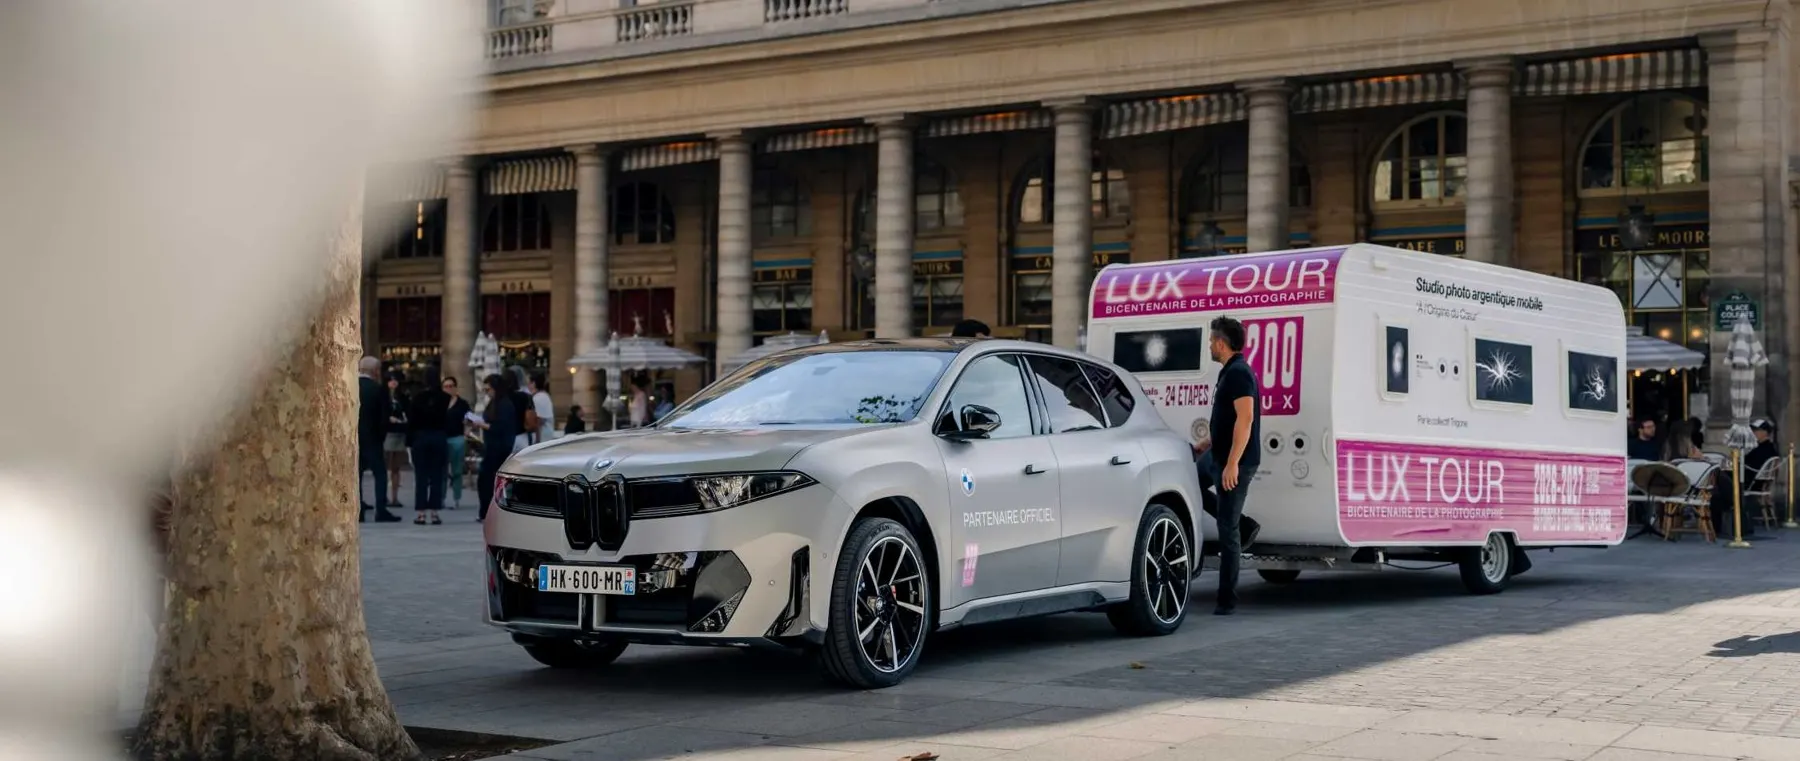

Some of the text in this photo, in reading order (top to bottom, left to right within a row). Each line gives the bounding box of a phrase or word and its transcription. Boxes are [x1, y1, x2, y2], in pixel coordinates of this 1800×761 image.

[1106, 258, 1330, 304] LUX TOUR
[1105, 290, 1326, 314] BICENTENAIRE DE LA PHOTOGRAPHIE
[1415, 277, 1543, 311] Studio photo argentique mobile
[1725, 304, 1749, 312] PLACE
[1165, 385, 1176, 406] 24
[1261, 394, 1294, 410] UX
[1347, 452, 1505, 504] LUX TOUR
[963, 507, 1056, 528] PARTENAIRE OFFICIEL
[1347, 505, 1505, 520] BICENTENAIRE DE LA PHOTOGRAPHIE
[550, 569, 623, 591] HK-600-MR
